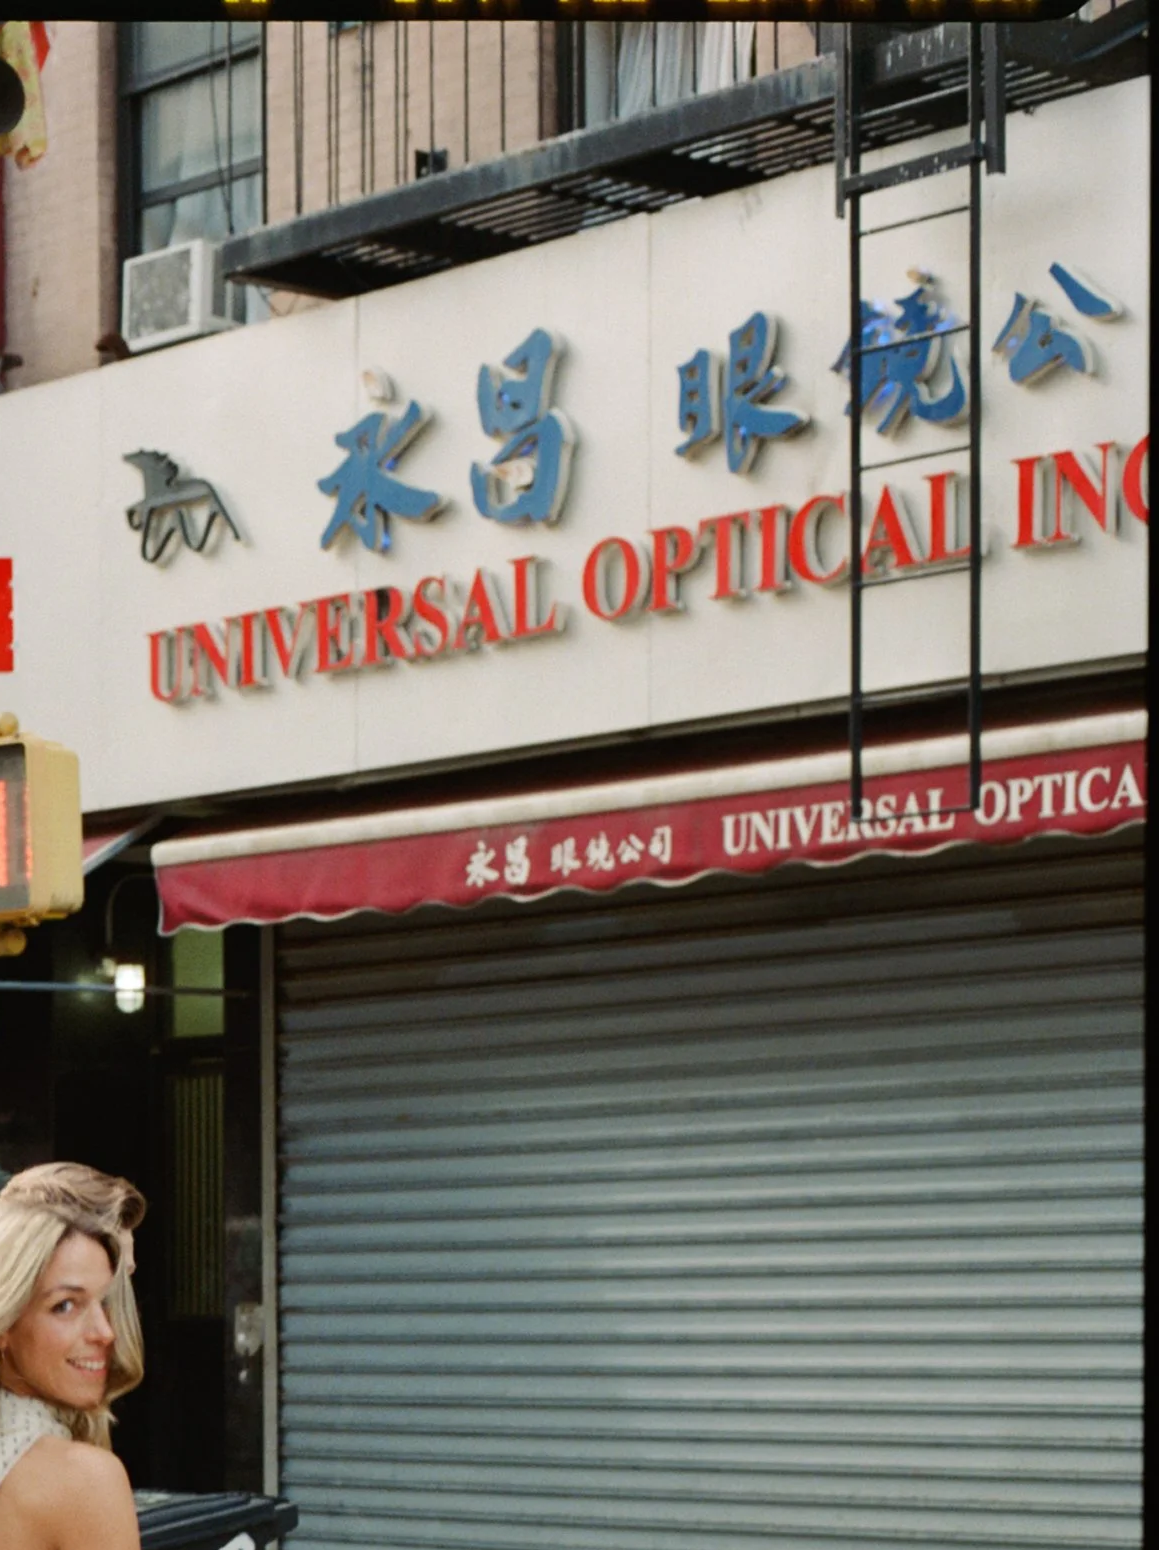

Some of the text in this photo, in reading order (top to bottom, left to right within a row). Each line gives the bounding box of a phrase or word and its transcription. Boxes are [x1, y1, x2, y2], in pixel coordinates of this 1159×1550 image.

[318, 326, 576, 553] 永昌
[147, 553, 566, 705] UNIVERSAL
[582, 470, 979, 622] OPTICAL
[722, 765, 1143, 857] UNIVERSAL OPTICA
